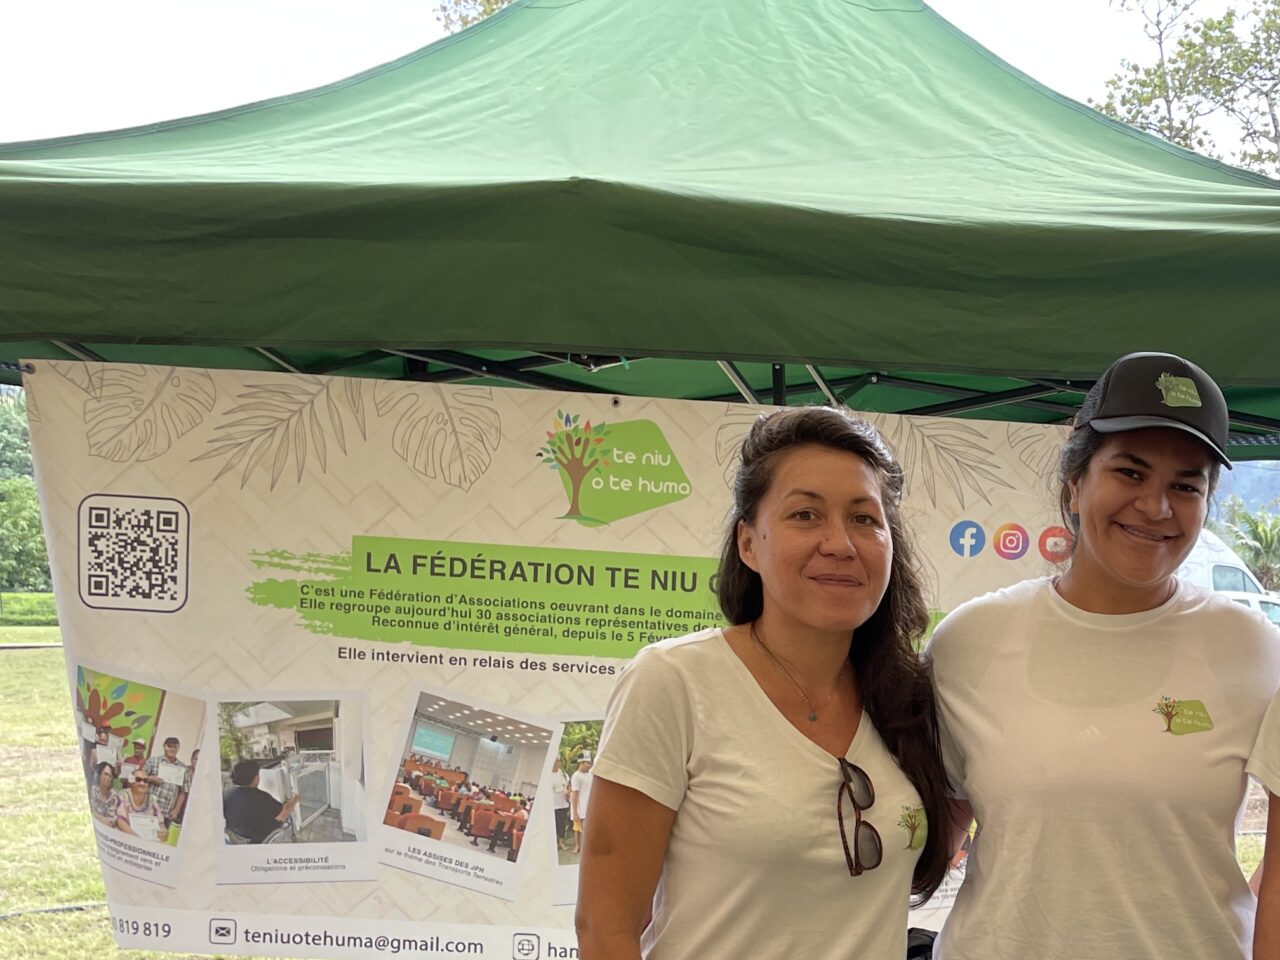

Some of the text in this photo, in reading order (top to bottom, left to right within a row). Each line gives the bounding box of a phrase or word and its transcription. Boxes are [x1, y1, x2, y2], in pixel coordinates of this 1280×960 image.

[612, 447, 671, 467] te niu
[591, 474, 690, 495] o te huma
[366, 551, 402, 576] LA
[411, 550, 595, 587] FÉDÉRATION
[605, 566, 640, 589] TE
[650, 569, 698, 593] NIU
[299, 584, 723, 622] C'est une Fédération d'Associations oeuvrant dans le domaine
[299, 598, 326, 610] Elle
[330, 601, 392, 615] regroupe
[395, 605, 472, 619] aujourd'hui
[476, 609, 492, 621] 30
[496, 611, 582, 626] associations
[585, 616, 689, 633] représentatives
[371, 615, 635, 643] Reconnue d'intérêt général, depuis le 5
[337, 646, 616, 676] Elle intervient en relais des services
[407, 846, 485, 874] LES ASSISES DES JPH
[118, 918, 139, 936] 819
[143, 922, 172, 939] 819
[244, 928, 484, 955] teniuotehuma@gmail.com
